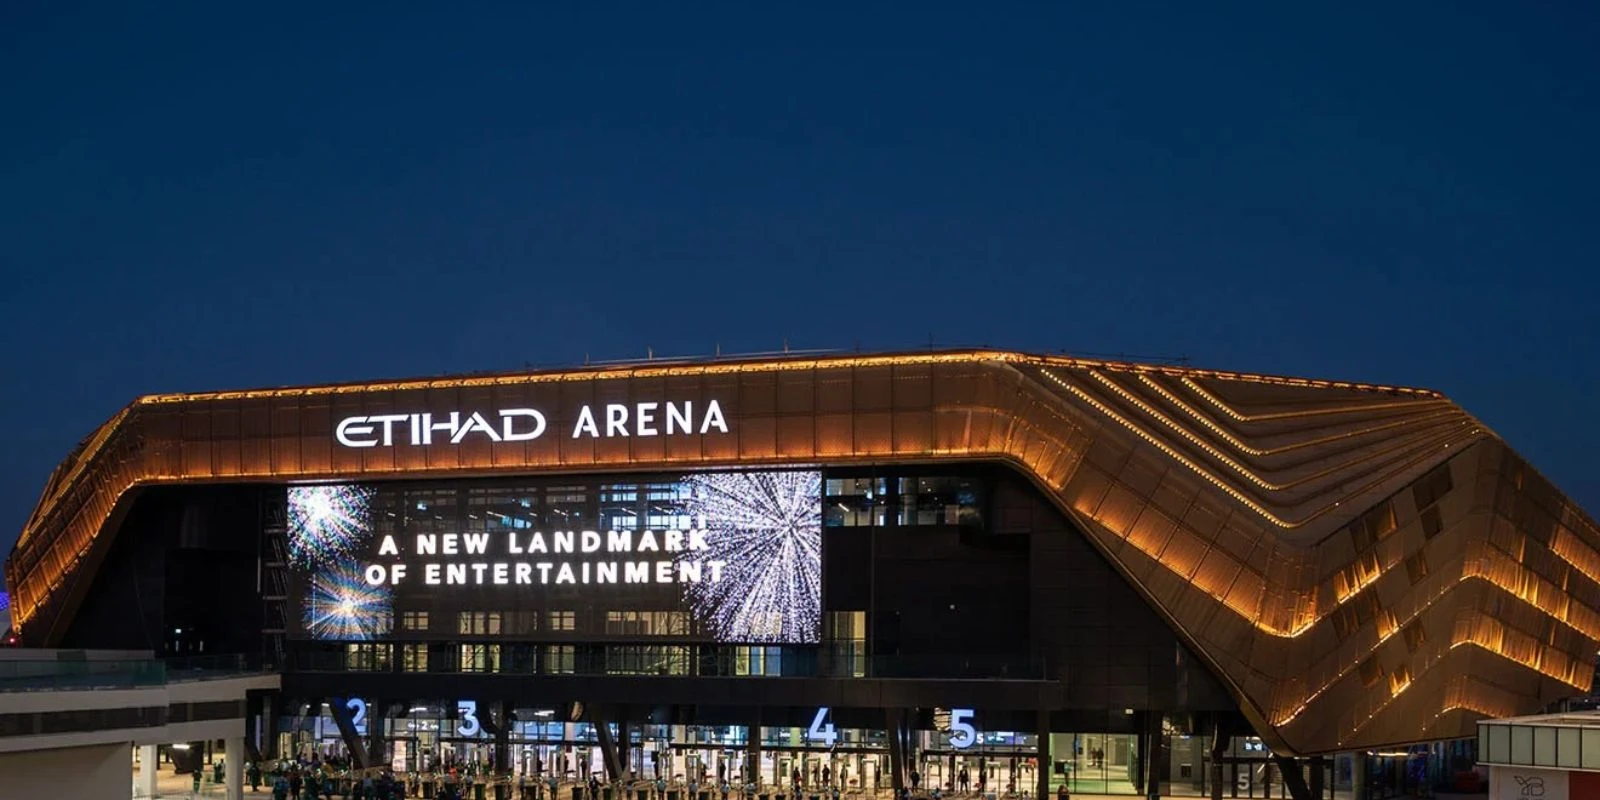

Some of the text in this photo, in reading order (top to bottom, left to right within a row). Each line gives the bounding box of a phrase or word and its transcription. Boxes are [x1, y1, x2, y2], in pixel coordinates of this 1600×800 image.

[336, 399, 729, 448] ETIHAD ARENA
[378, 529, 710, 557] A NEW LANDMARK
[365, 560, 727, 585] OF ENTERTAINMENT
[346, 698, 367, 735] 2
[457, 700, 480, 736] 3
[808, 707, 837, 745] 4
[949, 708, 976, 749] 5
[1237, 772, 1250, 790] 5
